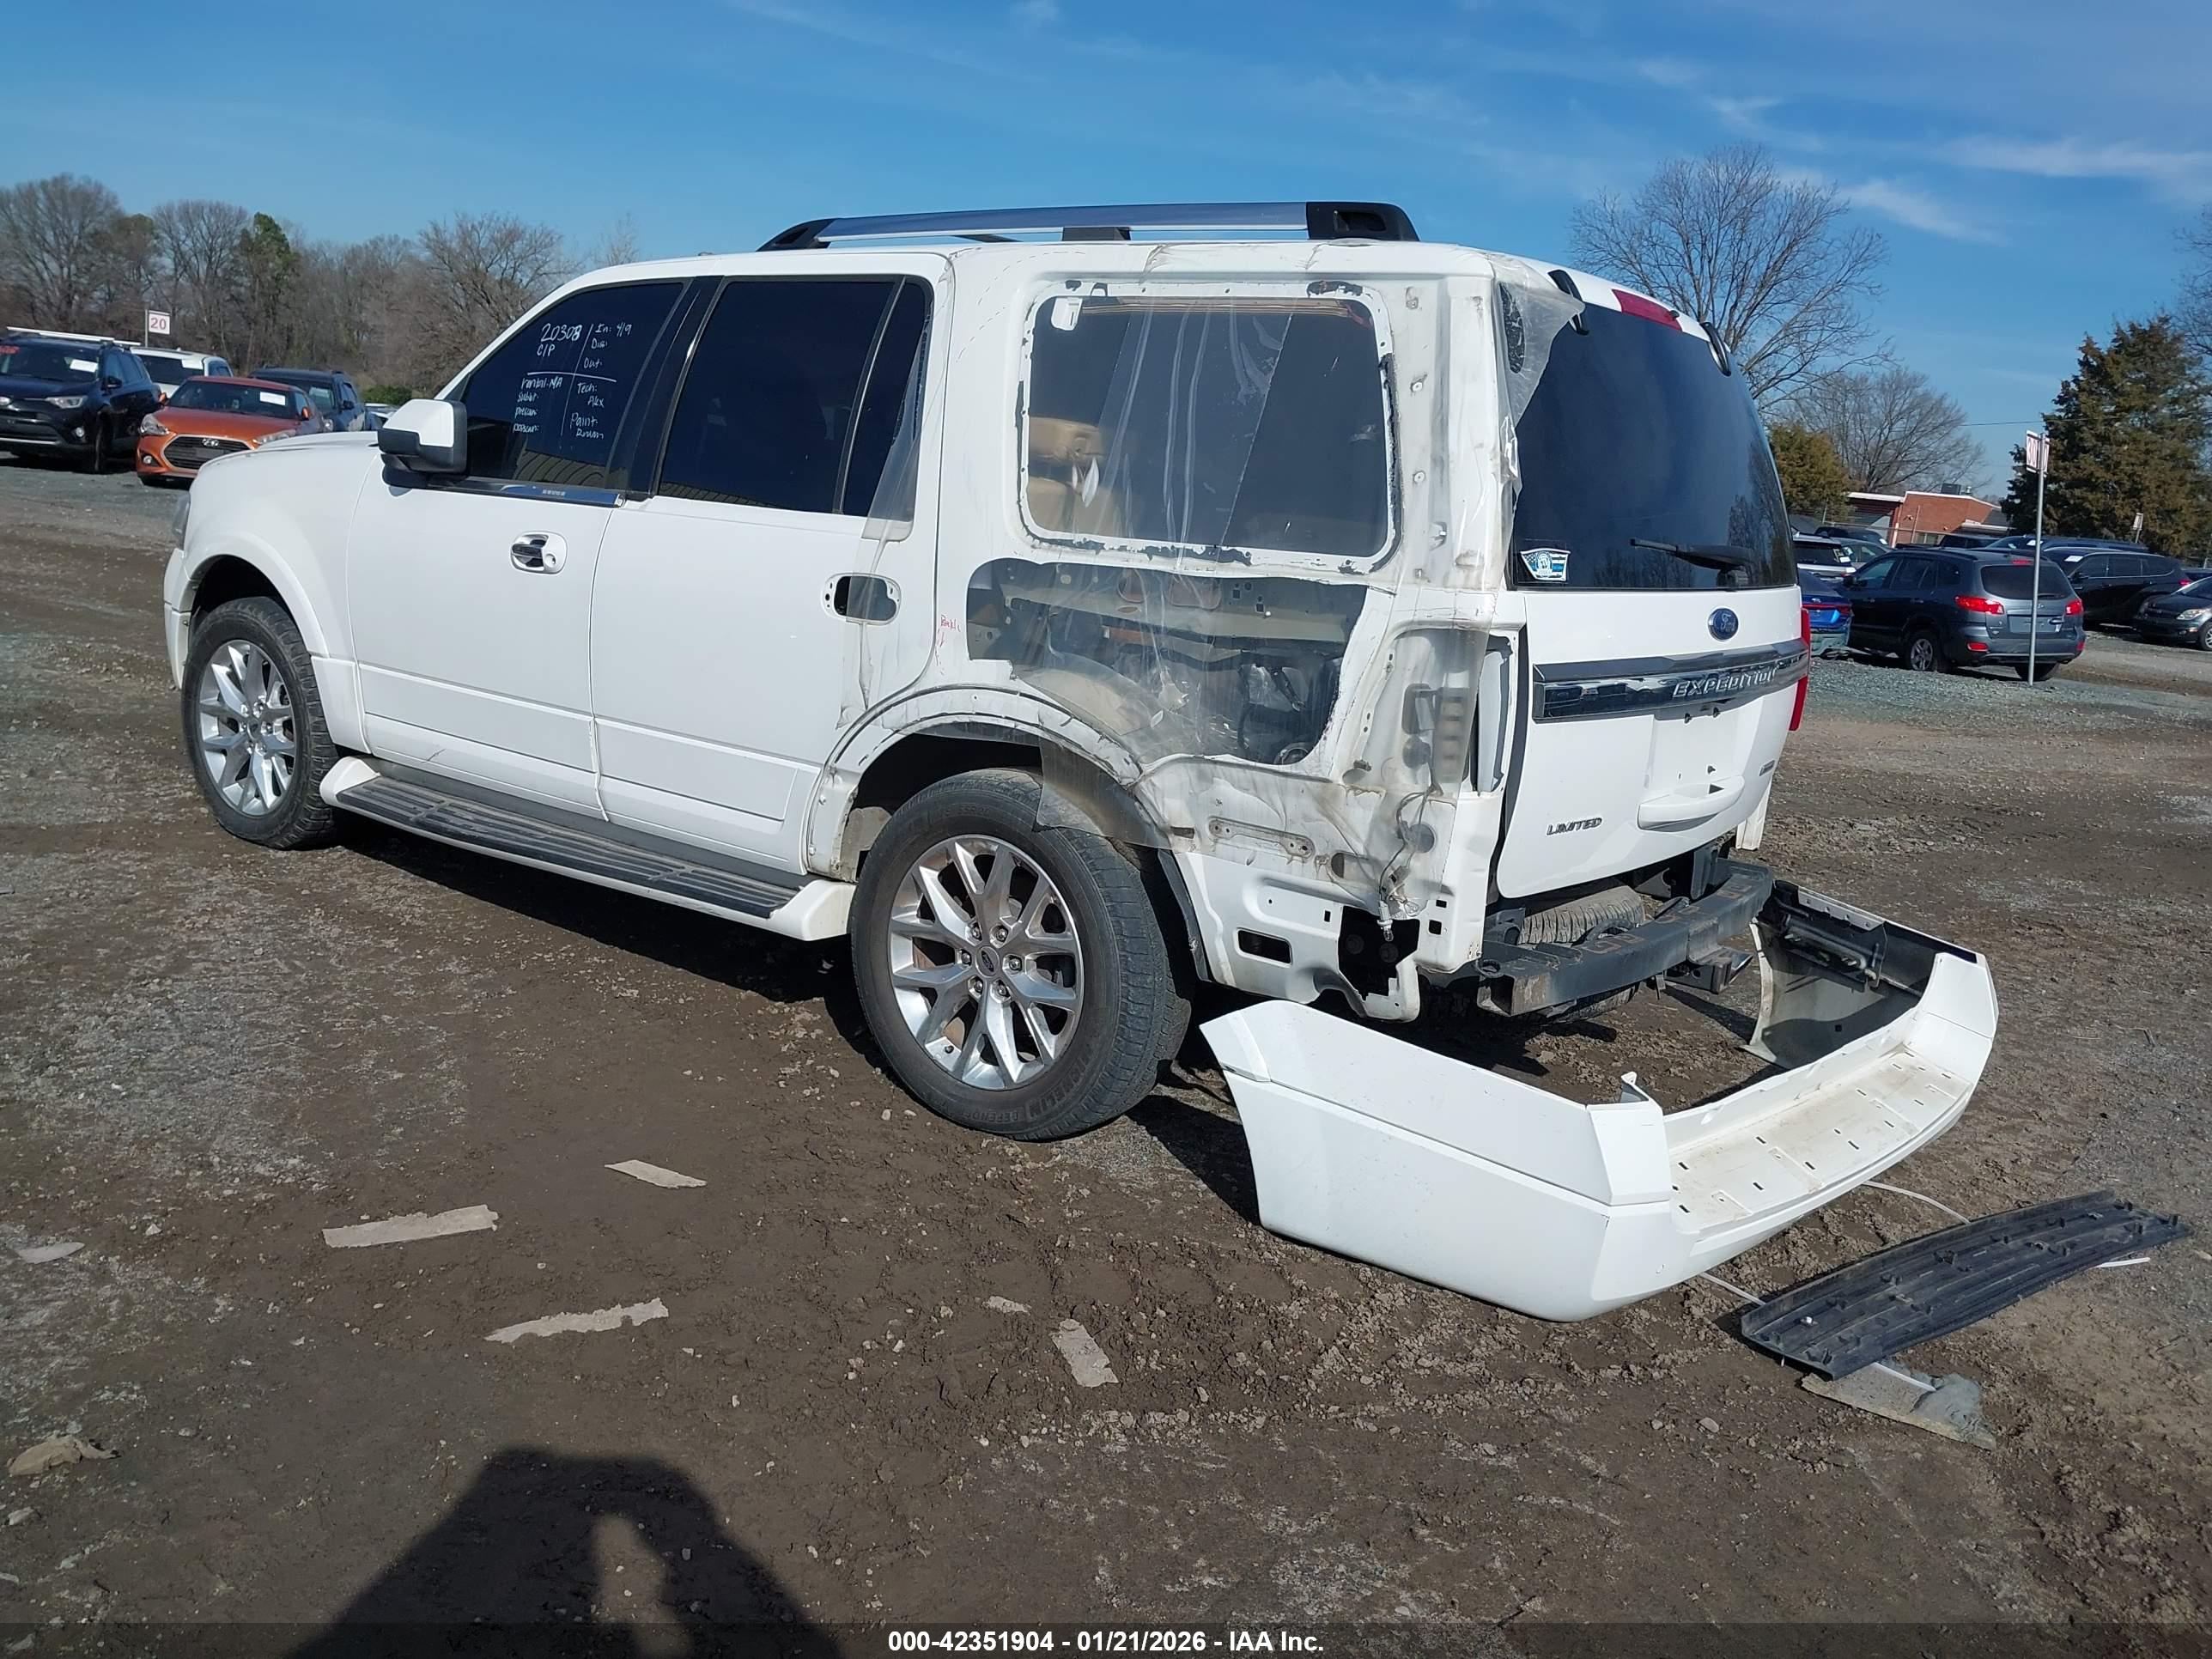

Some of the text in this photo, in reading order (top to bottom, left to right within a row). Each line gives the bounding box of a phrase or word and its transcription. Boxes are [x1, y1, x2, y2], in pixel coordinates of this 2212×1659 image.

[150, 317, 167, 330] 20
[541, 323, 583, 342] 20308
[1547, 817, 1602, 836] LIMITED
